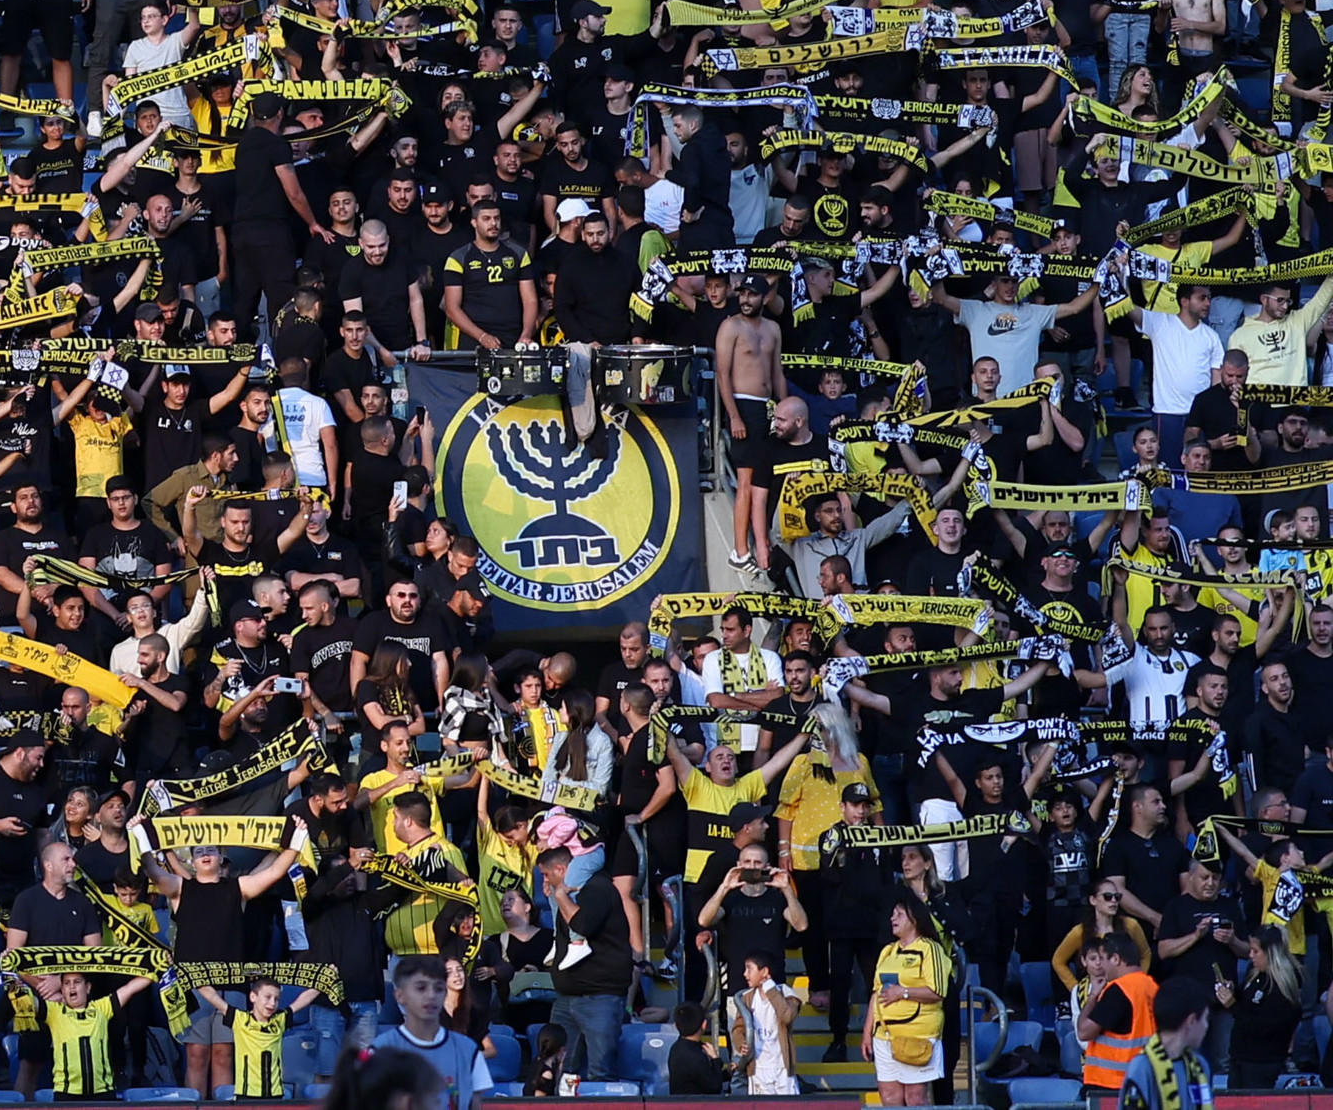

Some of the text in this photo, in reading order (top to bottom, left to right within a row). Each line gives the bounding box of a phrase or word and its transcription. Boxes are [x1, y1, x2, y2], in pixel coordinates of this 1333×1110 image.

[771, 39, 873, 63] ירושלים
[962, 46, 1061, 69] FAMILIA
[815, 98, 871, 112] ירושלים
[900, 100, 962, 115] JERUSALEM
[486, 265, 504, 282] 22
[668, 260, 711, 275] ירושלים
[748, 259, 793, 275] JERUSALEM
[962, 259, 1005, 274] ירושלים
[1045, 262, 1097, 276] JERUSALEM
[34, 295, 49, 312] FC
[993, 318, 1018, 330] NIKE
[40, 349, 97, 364] JERUSALEM
[139, 344, 226, 361] Jerusalem
[503, 534, 621, 570] ביתר
[475, 539, 662, 602] BEITAR JERUSALEM
[852, 598, 913, 615] ירושלים
[919, 601, 979, 620] JERUSALEM
[961, 640, 1021, 659] JERUSALEM
[866, 652, 922, 667] ירושלים
[1027, 718, 1064, 731] DON'T
[1037, 728, 1065, 740] WITH
[194, 750, 292, 798] BEITAR JERUSALEM
[161, 819, 284, 846] בית"ר ירושלים
